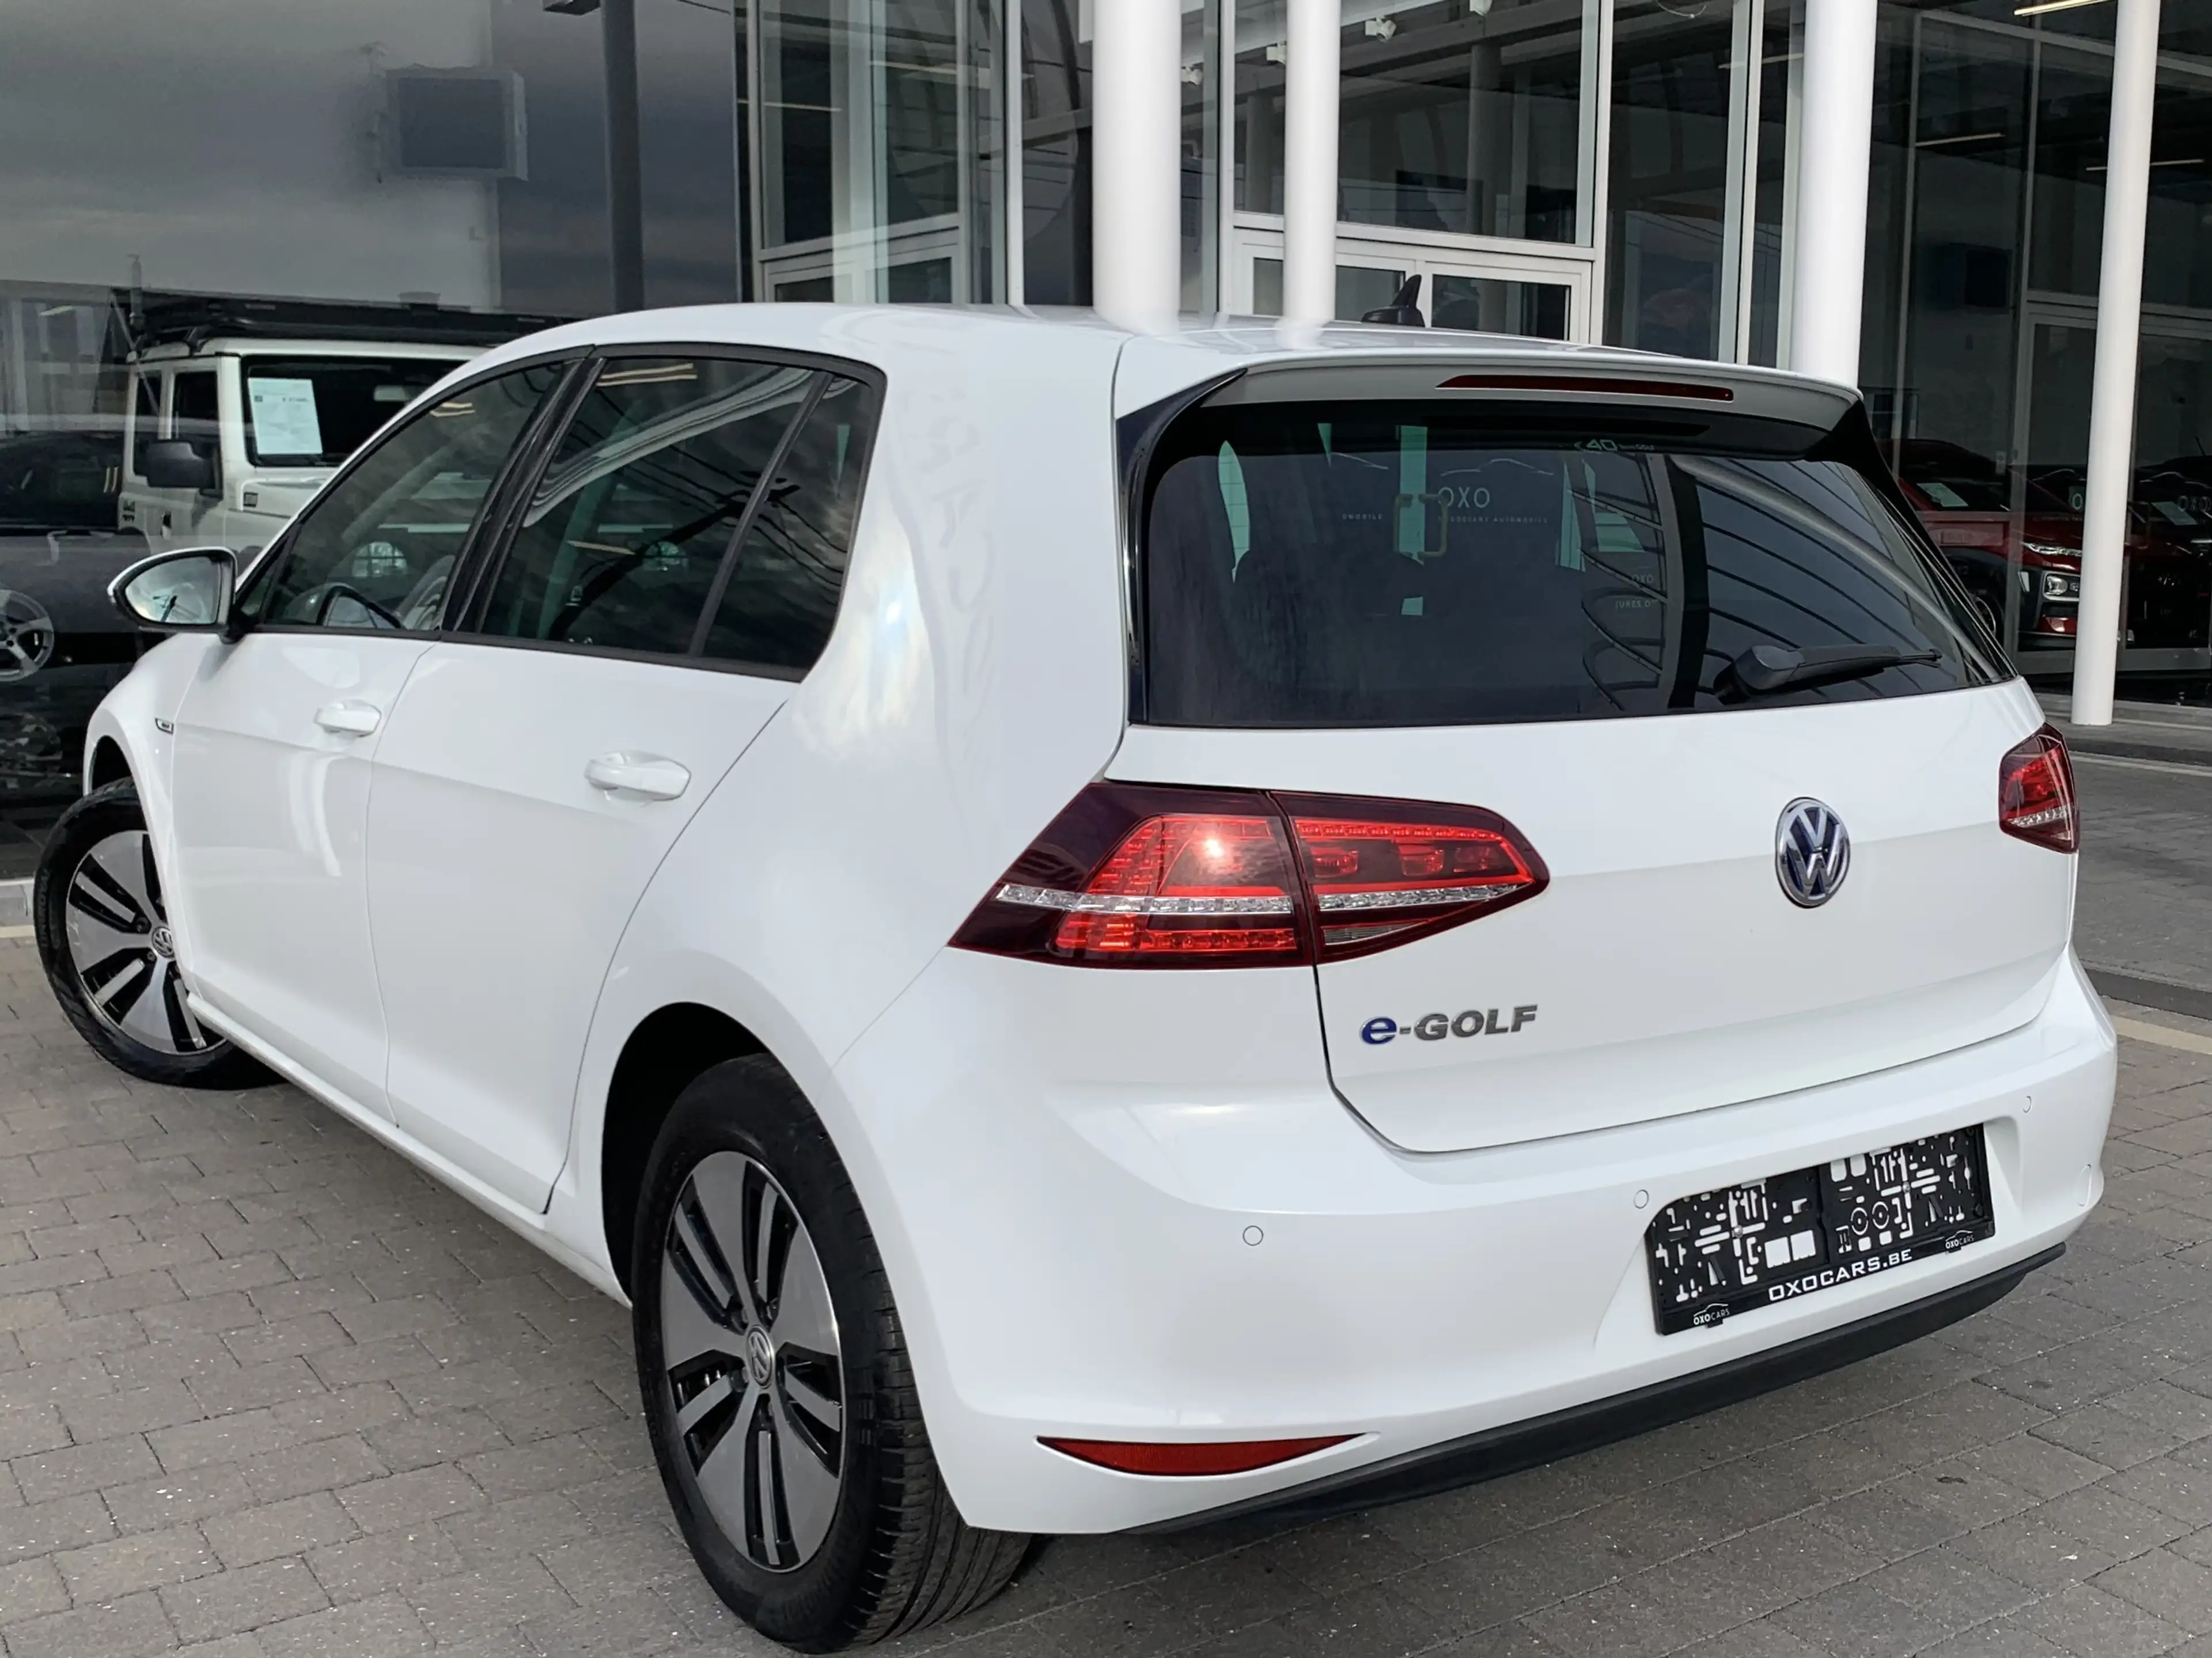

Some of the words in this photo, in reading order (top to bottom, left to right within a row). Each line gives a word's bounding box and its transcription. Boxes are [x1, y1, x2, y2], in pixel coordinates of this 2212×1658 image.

[1437, 485, 1491, 508] OXO
[1359, 1004, 1538, 1045] e-GOLF
[1945, 1234, 1975, 1249] OXOCARS
[1768, 1249, 1913, 1302] OXOCARS.BE
[1693, 1307, 1730, 1326] OXOCARS
